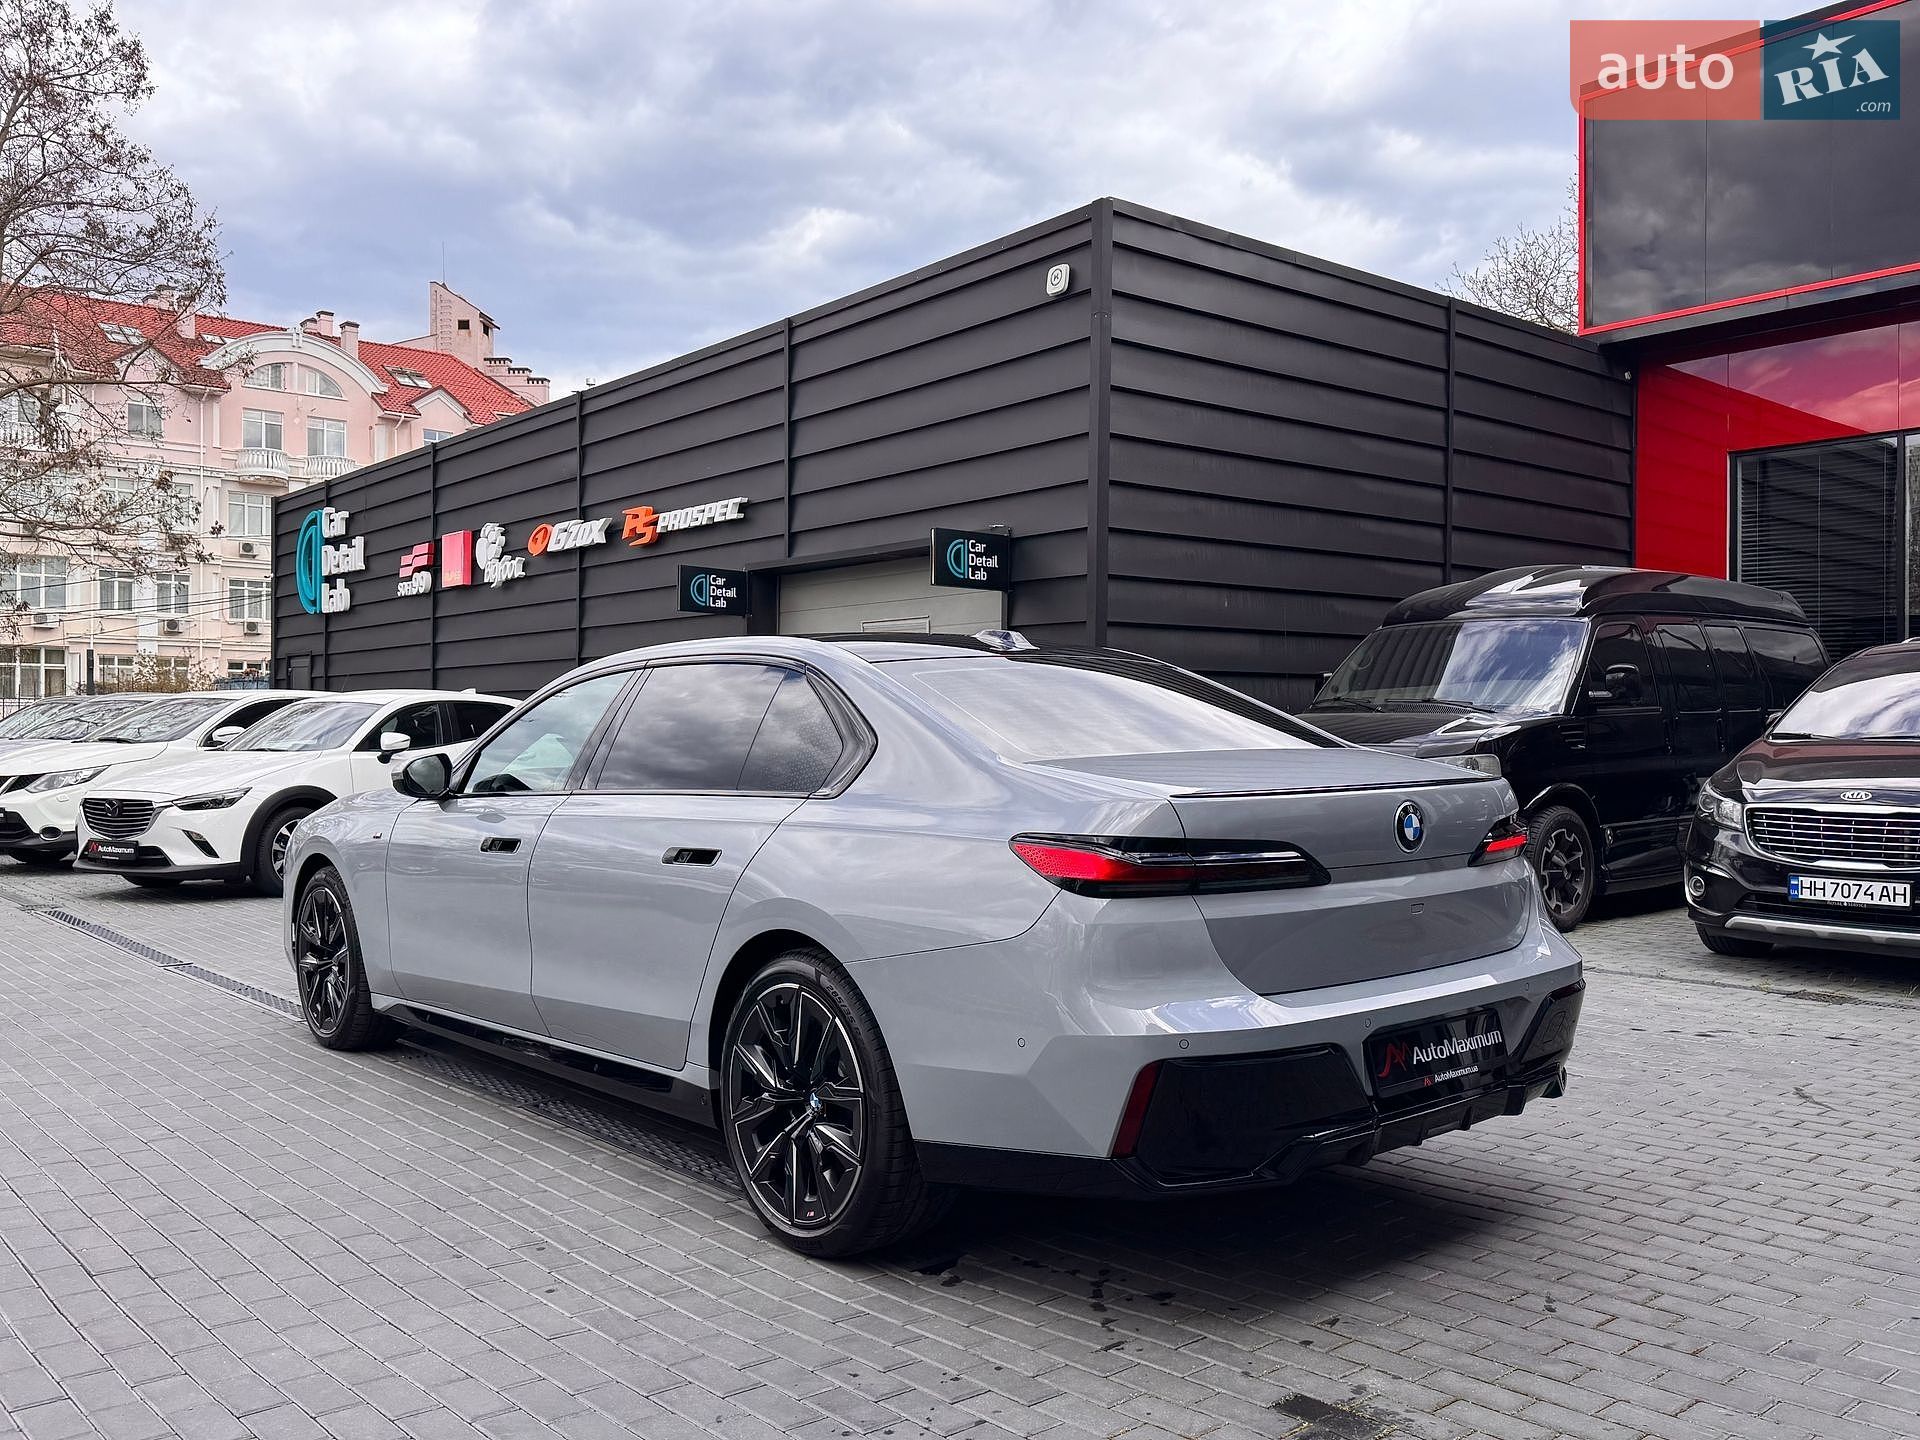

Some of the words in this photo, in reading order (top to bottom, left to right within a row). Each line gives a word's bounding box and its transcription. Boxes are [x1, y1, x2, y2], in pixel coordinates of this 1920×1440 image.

[322, 507, 349, 538] Car
[656, 497, 748, 533] PROSPEC
[968, 540, 986, 552] Car
[322, 536, 366, 576] Detail
[968, 553, 999, 568] Detail
[710, 575, 726, 585] Car
[968, 567, 987, 580] Lab
[321, 578, 350, 613] Lab
[710, 586, 737, 598] Detail
[710, 597, 727, 608] Lab
[1800, 880, 1826, 898] HH
[1829, 882, 1875, 901] 7074
[1878, 885, 1908, 904] AH
[1413, 1030, 1502, 1064] AutoMaximum
